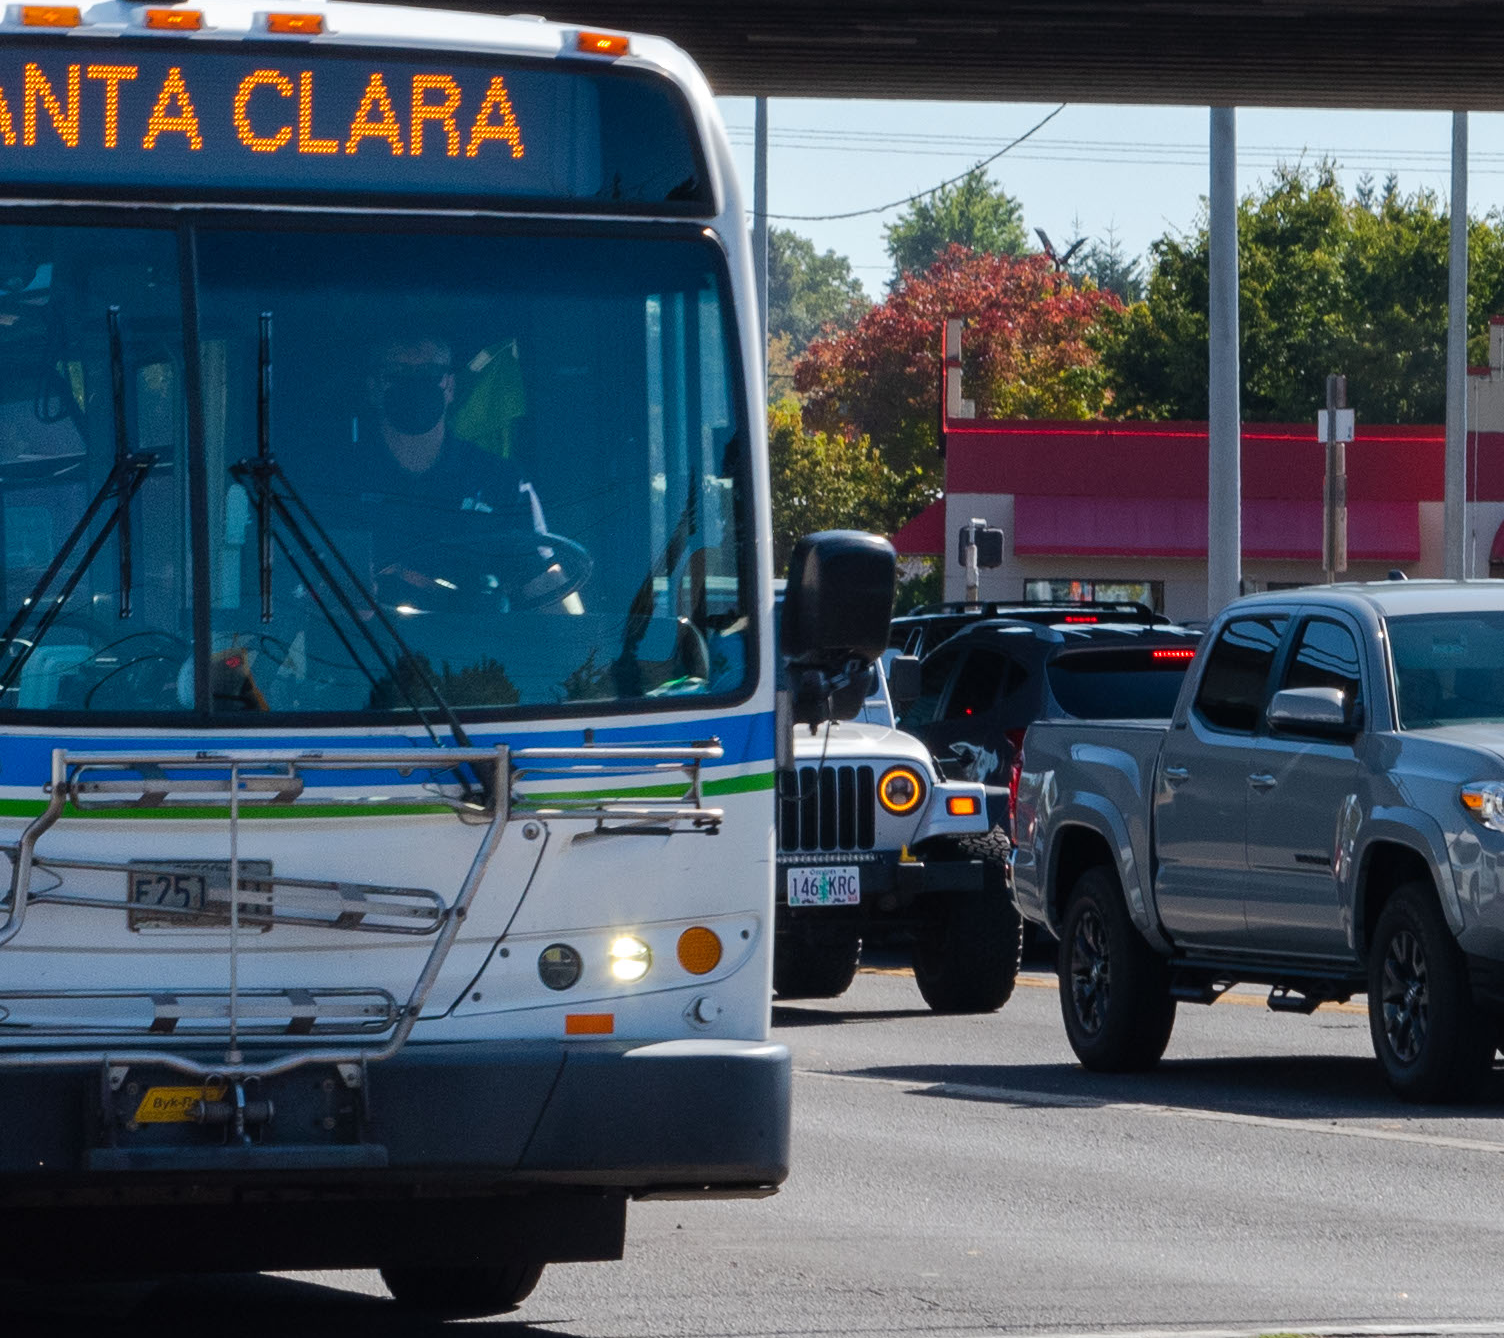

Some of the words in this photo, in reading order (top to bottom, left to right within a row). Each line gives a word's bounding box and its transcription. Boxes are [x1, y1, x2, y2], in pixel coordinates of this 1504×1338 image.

[233, 69, 525, 159] CLARA
[793, 876, 819, 897] 146
[828, 875, 857, 896] KRC
